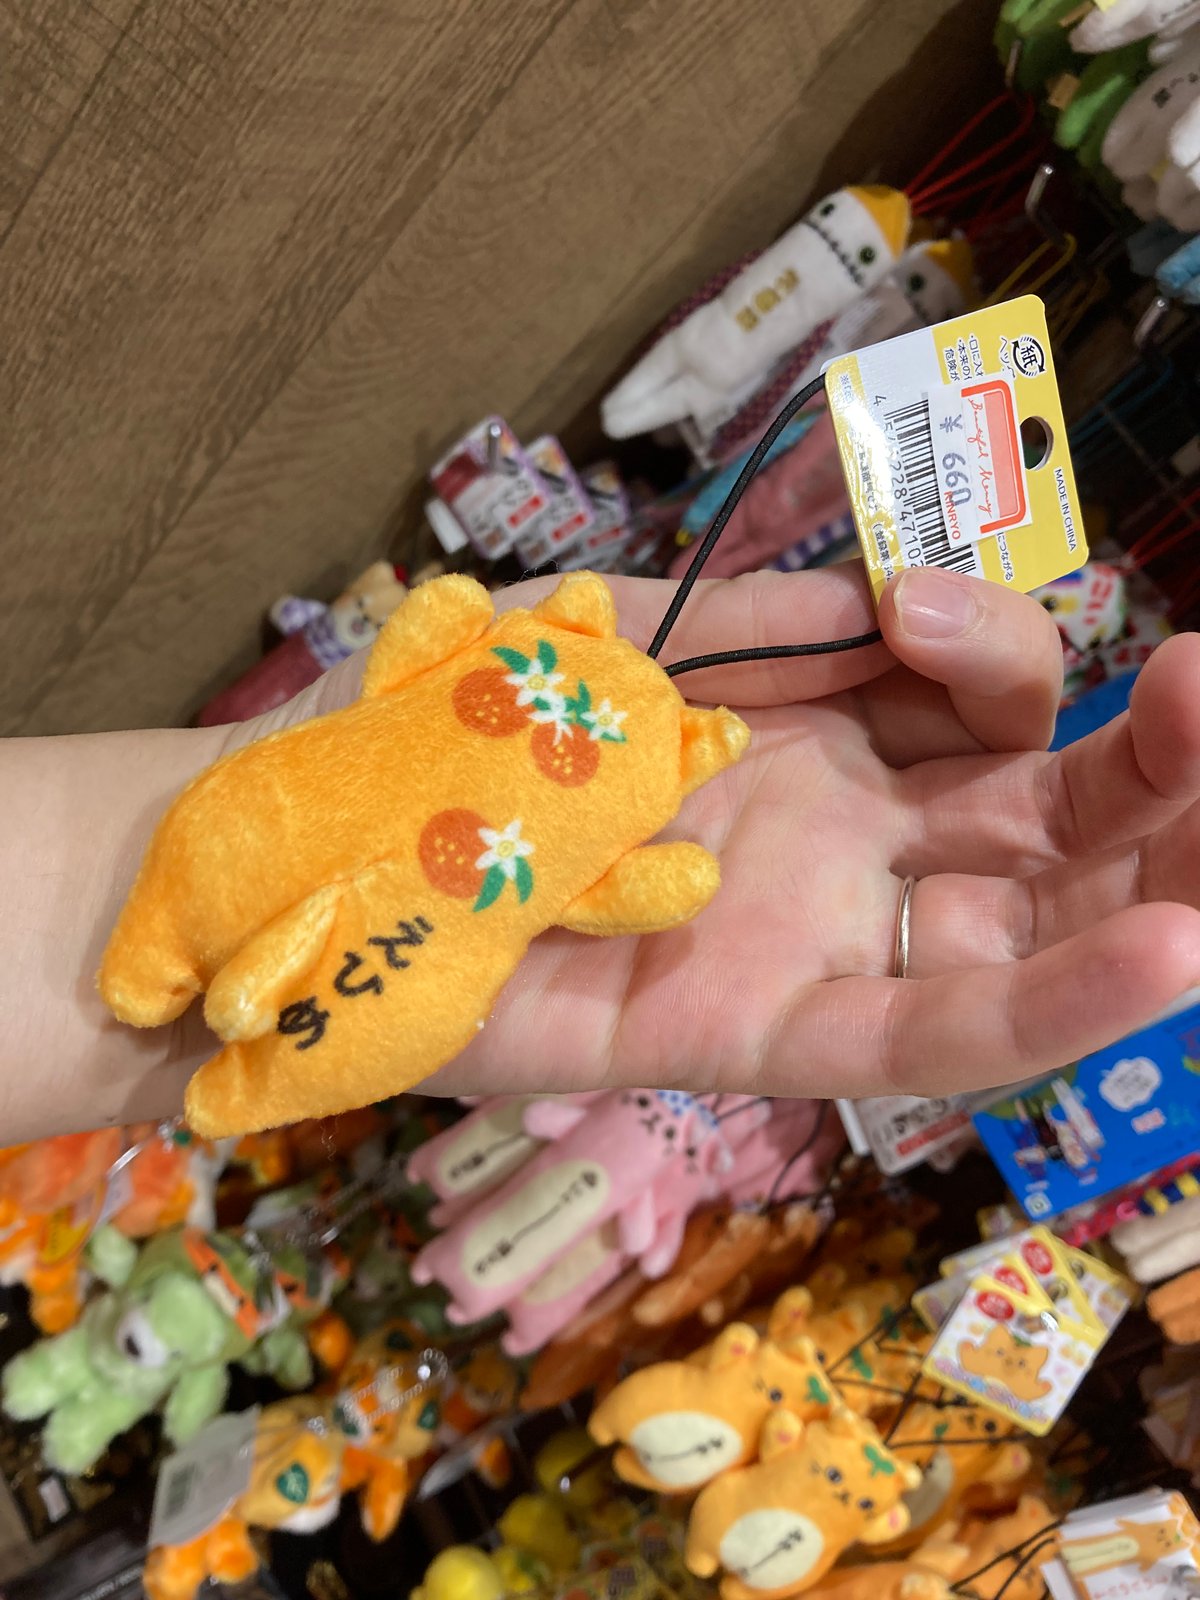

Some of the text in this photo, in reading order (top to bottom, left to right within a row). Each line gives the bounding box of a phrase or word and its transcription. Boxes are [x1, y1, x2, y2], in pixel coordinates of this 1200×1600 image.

[1020, 345, 1038, 368] 紙
[873, 395, 886, 406] 4
[940, 414, 972, 506] ¥ 660
[1055, 469, 1077, 552] MADE IN CHINA
[277, 915, 435, 1050] えひめ
